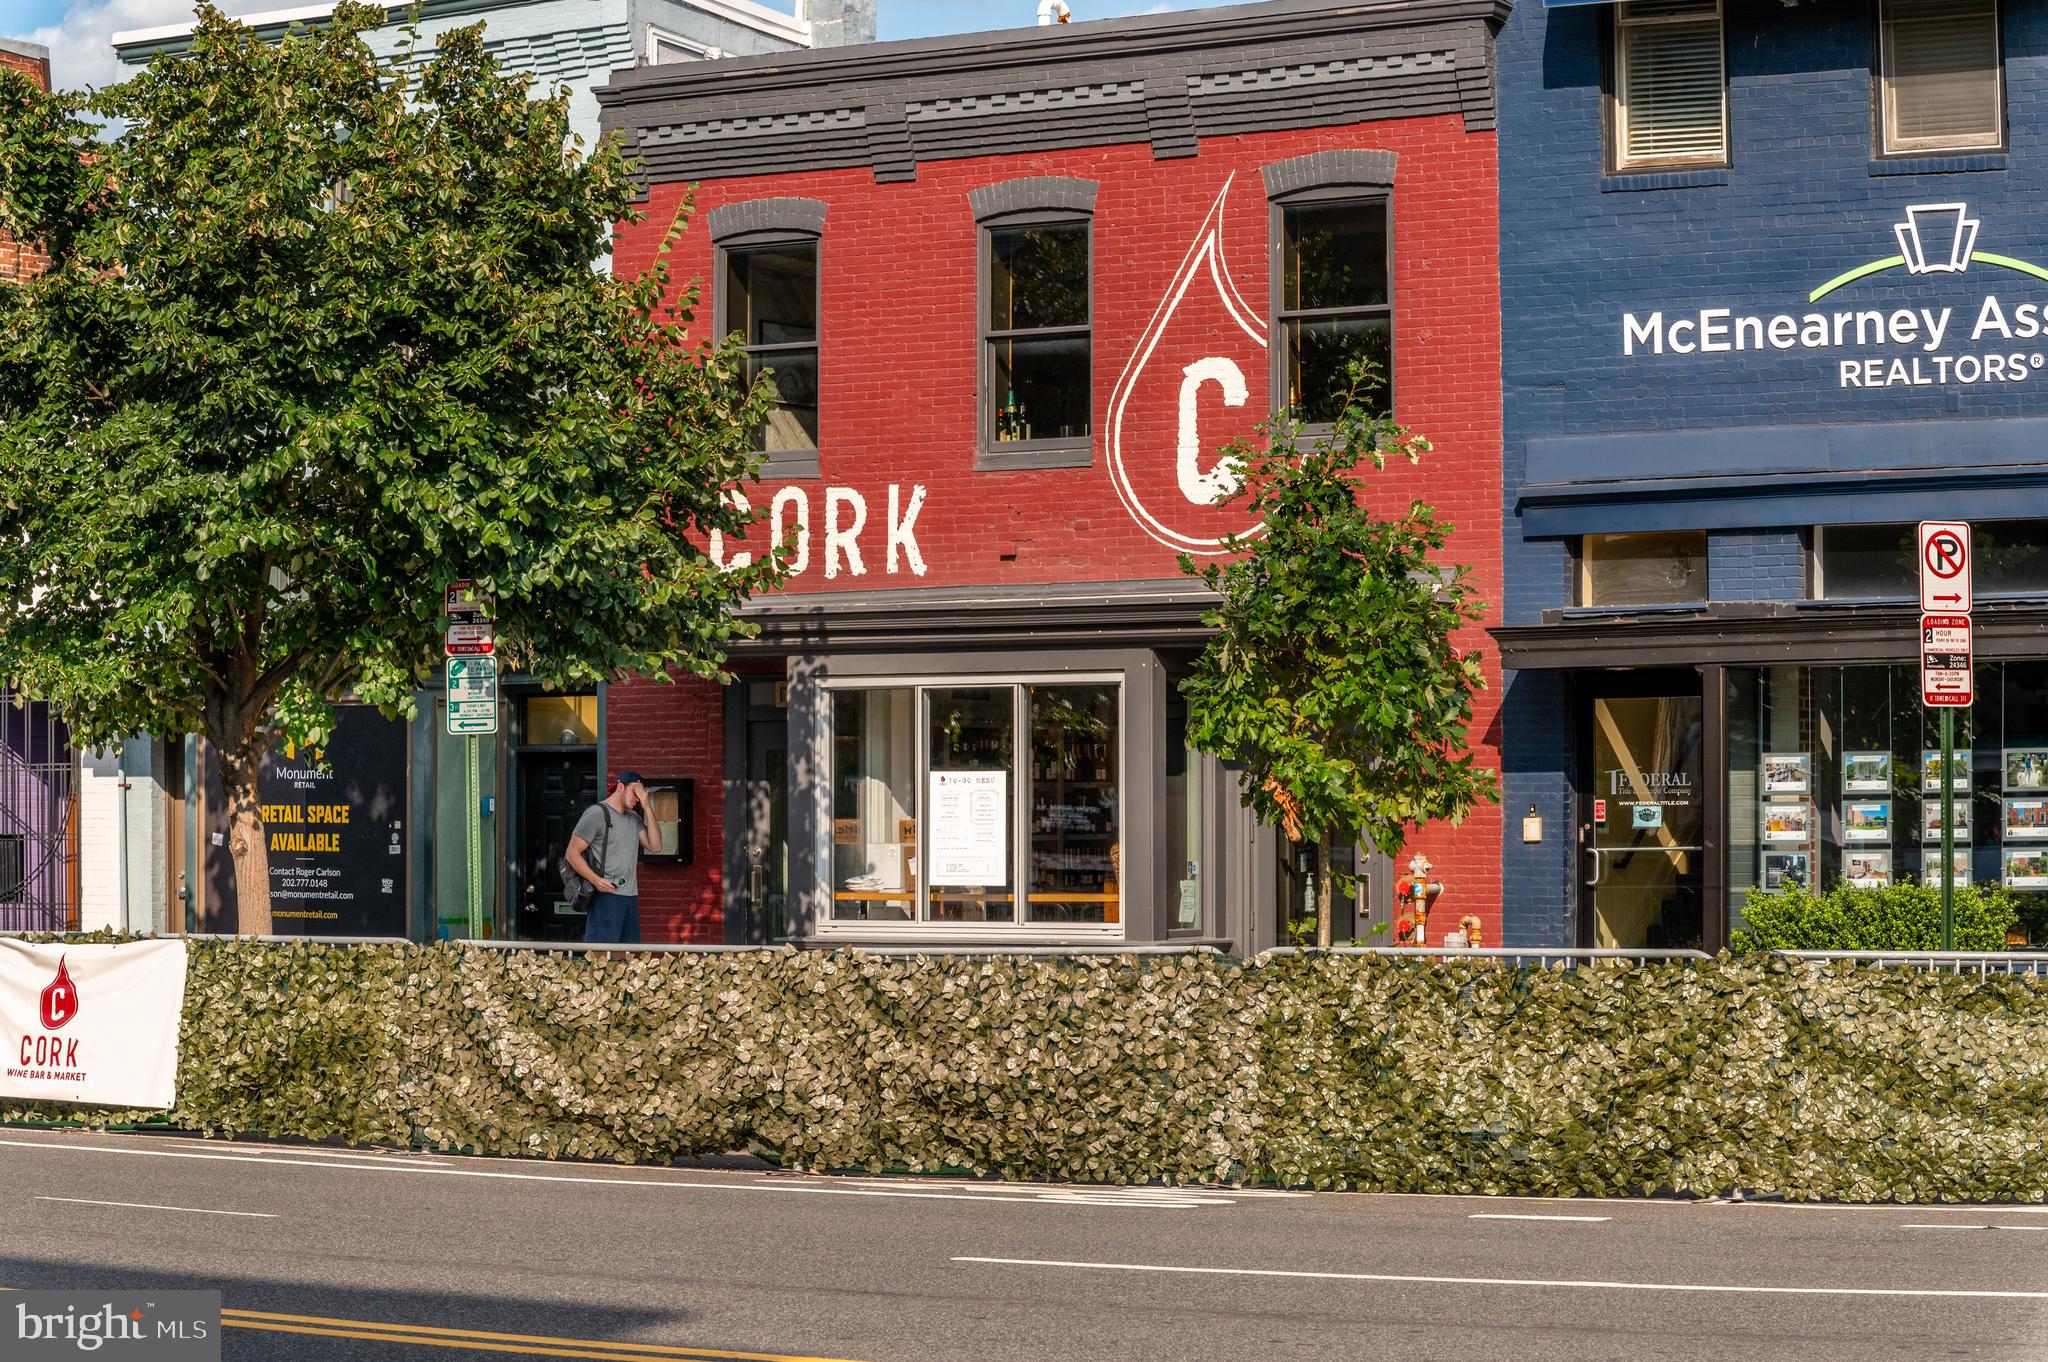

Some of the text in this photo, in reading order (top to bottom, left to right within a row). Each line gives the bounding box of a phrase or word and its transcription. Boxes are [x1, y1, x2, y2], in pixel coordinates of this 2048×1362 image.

[1623, 296, 2048, 356] McEnearney As
[1177, 357, 1249, 505] C
[710, 484, 928, 580] CORK
[449, 591, 456, 603] 2
[1927, 618, 1965, 626] LOADING ZONE
[1925, 628, 1932, 643] 2
[1949, 654, 1967, 662] Zone:
[1949, 661, 1967, 669] 24346
[452, 680, 457, 688] 2
[276, 766, 334, 780] Monument
[294, 781, 316, 789] RETAIL
[1663, 787, 1692, 796] Company
[261, 804, 350, 824] RETAIL SPACE
[270, 833, 340, 852] AVAILABLE
[269, 866, 341, 878] Contact Roger Carlson
[281, 878, 328, 888] 202.777.0148
[271, 909, 338, 920] monumentretail.com
[51, 987, 65, 1021] C
[20, 1034, 79, 1067] CORK
[7, 1068, 87, 1081] WINE BAR & MARKET
